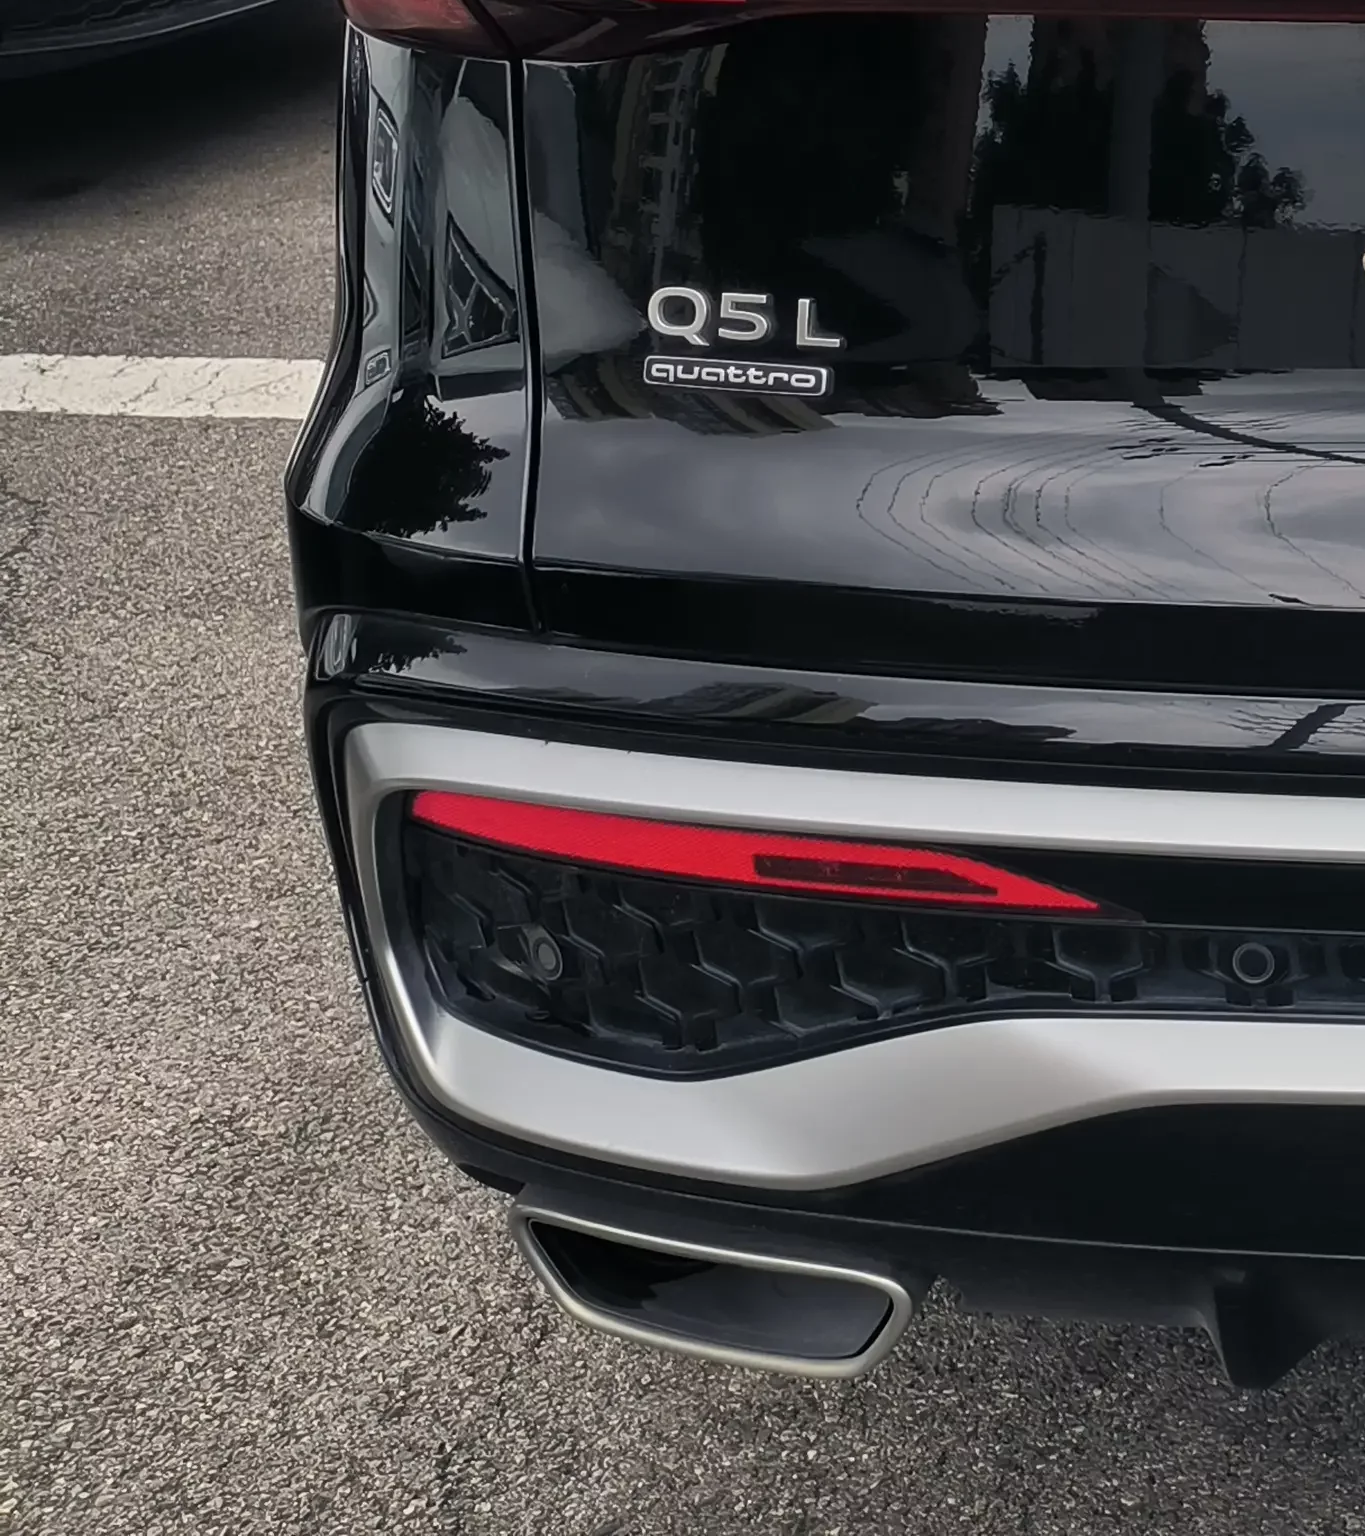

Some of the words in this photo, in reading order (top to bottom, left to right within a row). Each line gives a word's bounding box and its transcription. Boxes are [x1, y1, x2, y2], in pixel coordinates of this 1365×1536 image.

[646, 286, 770, 346] Q5
[795, 297, 842, 348] L
[650, 362, 817, 389] quattro
